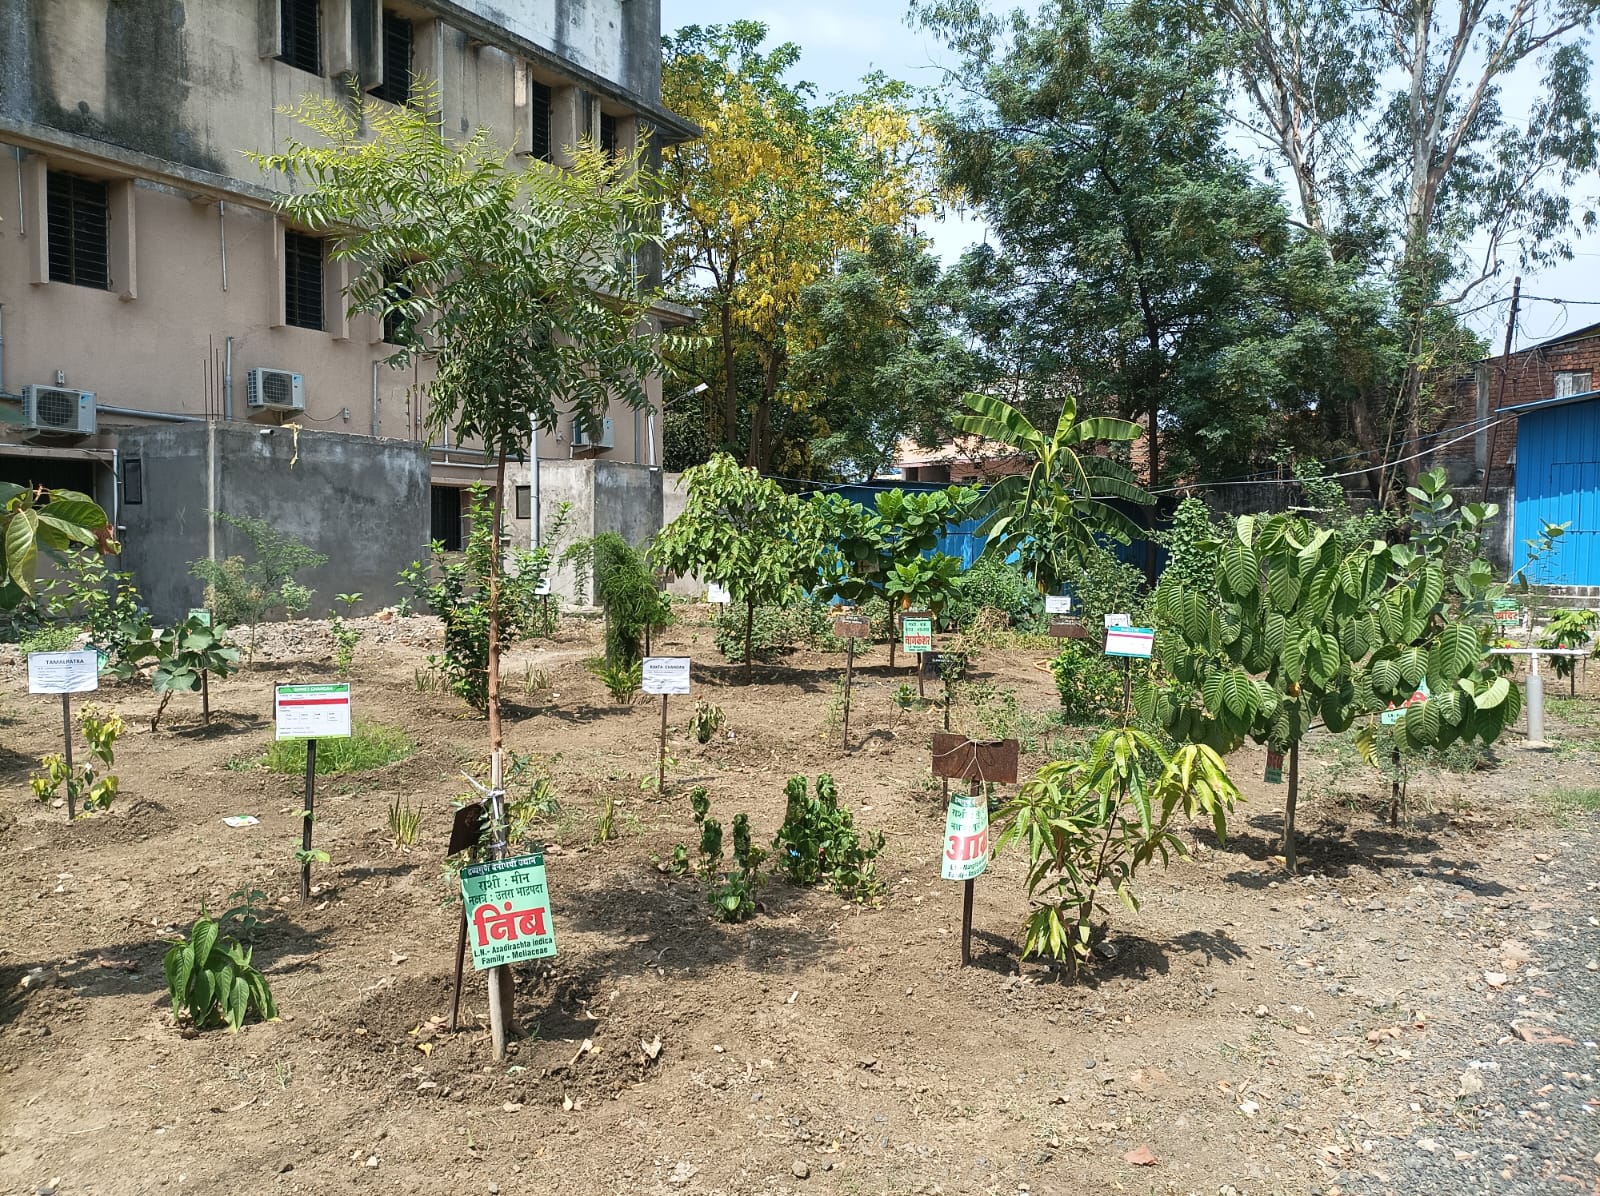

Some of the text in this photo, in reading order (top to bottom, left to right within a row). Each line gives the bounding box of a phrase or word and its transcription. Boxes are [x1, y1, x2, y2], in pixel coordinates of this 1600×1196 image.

[478, 874, 501, 891] राशी
[510, 871, 530, 885] मीन
[473, 901, 547, 947] निंब
[491, 939, 532, 954] Azadirachta
[481, 953, 505, 965] Family
